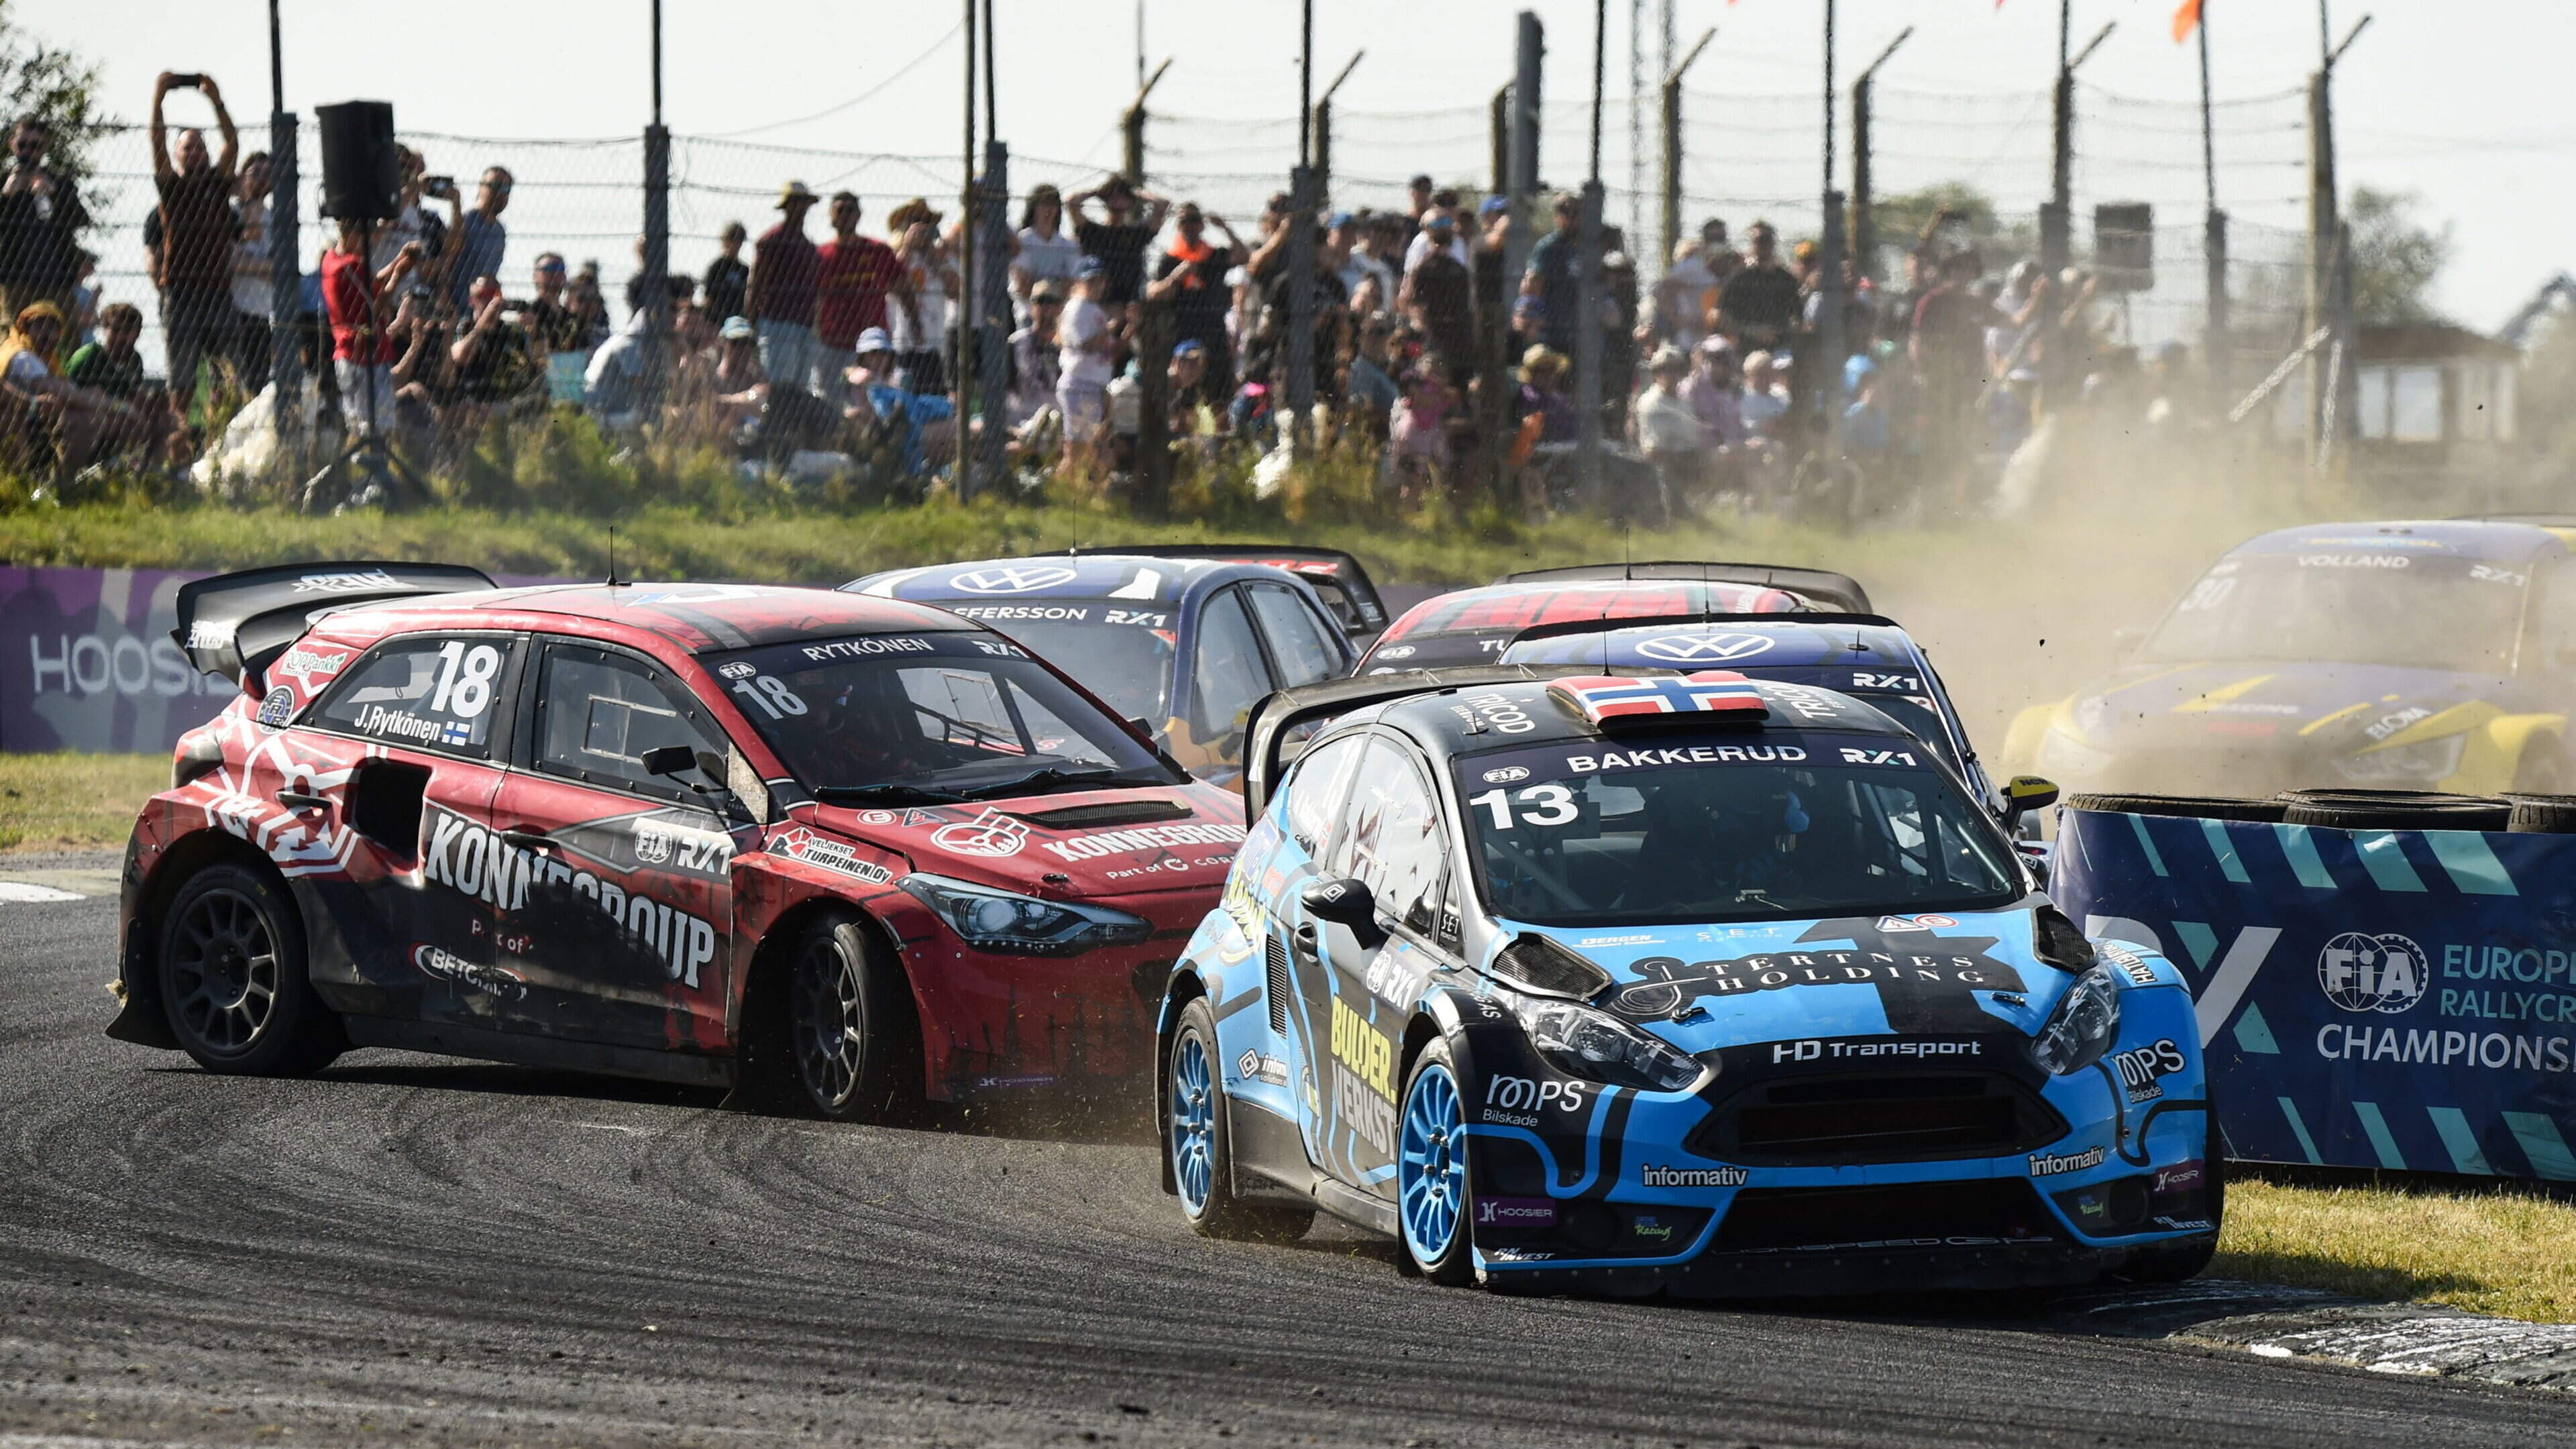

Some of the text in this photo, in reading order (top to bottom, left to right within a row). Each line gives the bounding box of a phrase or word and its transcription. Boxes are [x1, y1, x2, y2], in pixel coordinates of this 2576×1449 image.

[2298, 555, 2410, 569] VOLLAND
[1104, 610, 1167, 627] RX1
[802, 637, 934, 661] RYTKÖNEN
[972, 641, 1030, 659] RX1
[430, 640, 499, 718] 18
[721, 663, 755, 678] FIA
[1852, 673, 1918, 690] RX1
[731, 676, 808, 720] 18
[1762, 683, 1837, 718] TRICO
[354, 704, 441, 741] J.Rytkönen
[1567, 746, 1806, 773] BAKKERUD
[1839, 747, 1917, 767] RX1
[1485, 767, 1529, 782] FIA
[1469, 784, 1578, 830] 13
[678, 836, 731, 875] RX1
[811, 838, 854, 856] VELJEKSET
[804, 849, 871, 876] TURPEINEN
[1106, 868, 1144, 880] Part
[1146, 863, 1163, 873] of
[1705, 952, 1974, 975] TERTNES
[1383, 964, 1417, 1011] RX1
[1717, 966, 1984, 991] HOLDING
[1829, 1040, 1981, 1059] Transport
[2316, 1023, 2576, 1073] CHAMPIONS
[1331, 1059, 1397, 1161] VERKST
[1483, 1108, 1538, 1127] Bilskade
[2029, 1146, 2104, 1177] informativ
[1643, 1164, 1748, 1187] informativ
[1497, 1208, 1553, 1218] HOOSIER
[1635, 1224, 1672, 1241] Racing
